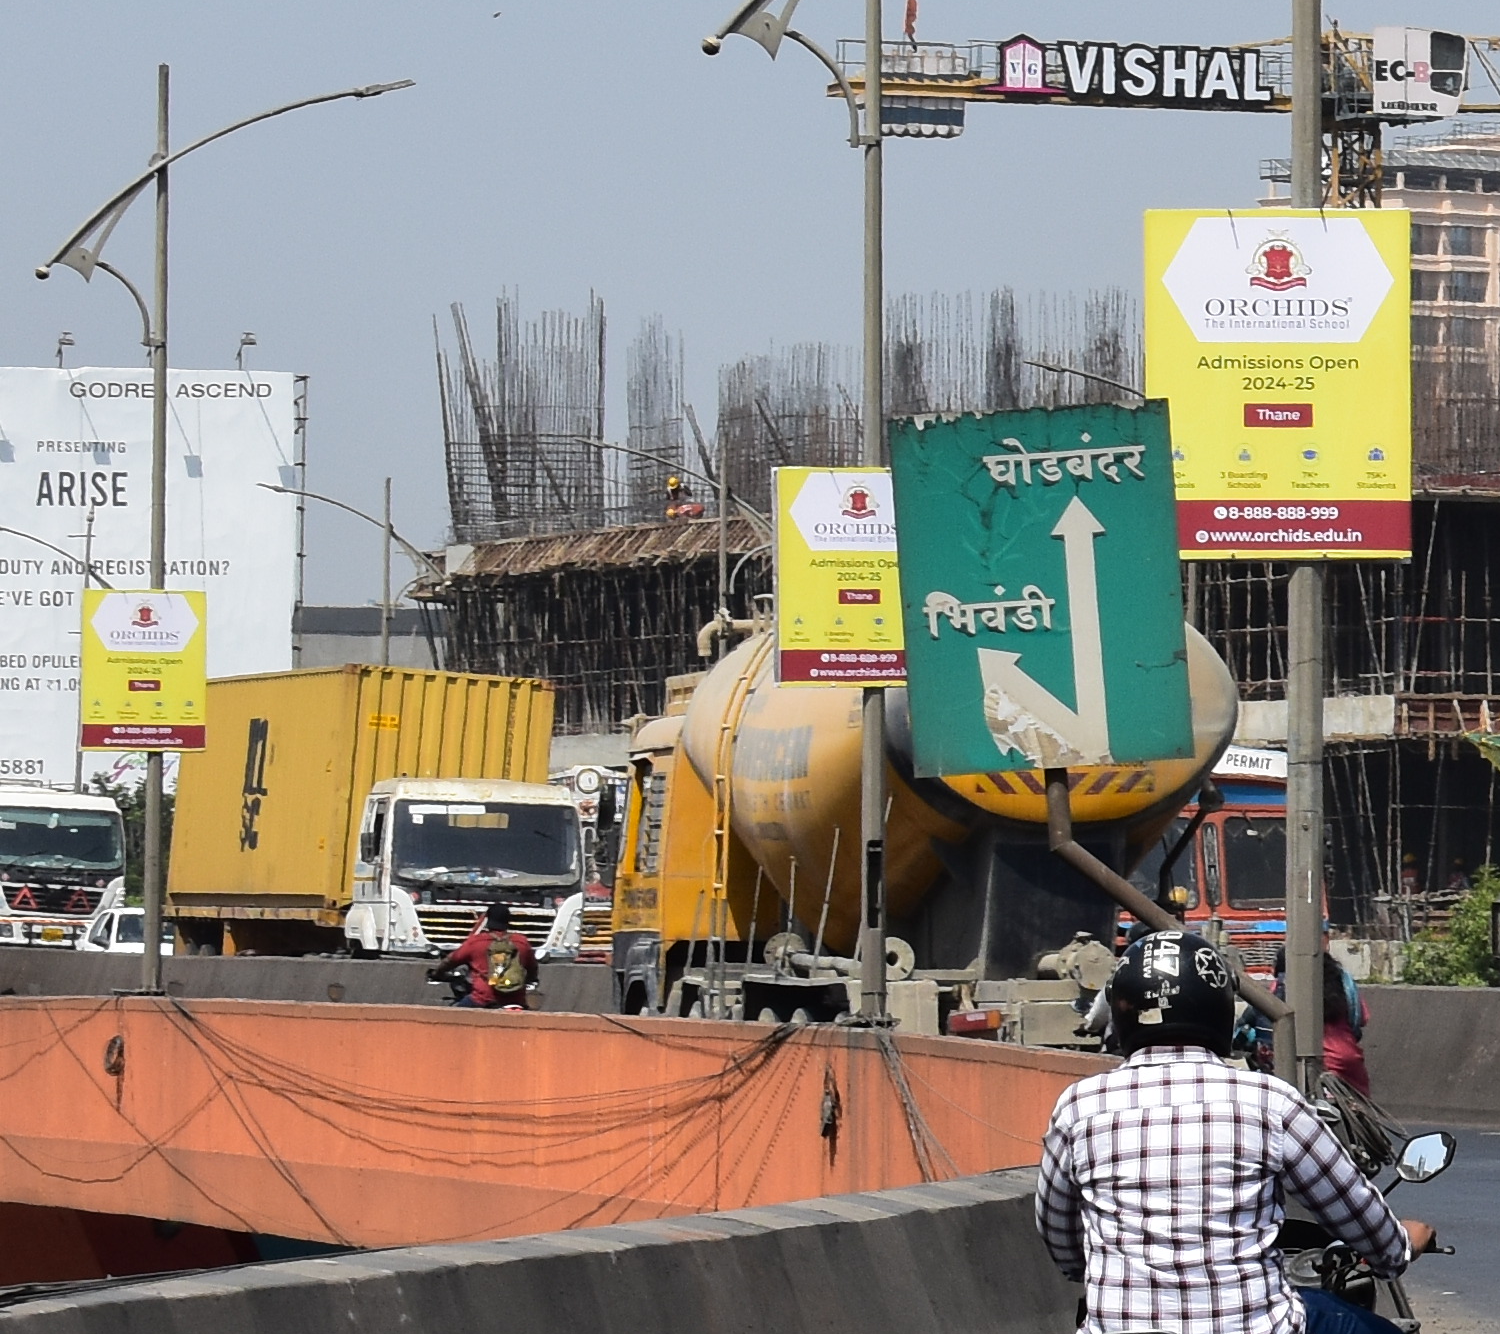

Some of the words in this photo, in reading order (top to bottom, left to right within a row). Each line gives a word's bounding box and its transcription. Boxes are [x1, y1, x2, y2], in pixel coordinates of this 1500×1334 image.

[1062, 44, 1271, 102] VISHAL
[1375, 59, 1430, 83] EC-B
[1205, 298, 1349, 317] ORCHIDS
[1205, 319, 1225, 329] The
[1229, 318, 1306, 329] International
[1310, 318, 1350, 329] School
[1197, 355, 1304, 370] Admissions
[1309, 355, 1359, 372] Open
[69, 382, 156, 399] GODRE
[175, 383, 272, 399] ASCEND
[1242, 377, 1315, 391] 2024-25
[1256, 408, 1301, 421] Thane
[36, 440, 127, 454] PRESENTING
[982, 432, 1146, 486] घोडबंदर
[36, 472, 129, 507] ARISE
[1291, 480, 1329, 489] Teachers
[1356, 481, 1396, 490] Students
[1228, 506, 1339, 520] 8-888-888-999
[1211, 528, 1362, 543] www.orchids.edu.in
[810, 558, 874, 568] Admissions
[837, 572, 882, 582] 2024-25
[40, 590, 75, 607] GOT
[922, 584, 1056, 640] भिवंडी
[0, 654, 27, 668] BED
[32, 654, 81, 668] OPULE
[25, 677, 41, 691] AT
[0, 759, 44, 775] 5881
[1226, 753, 1273, 770] PERMIT
